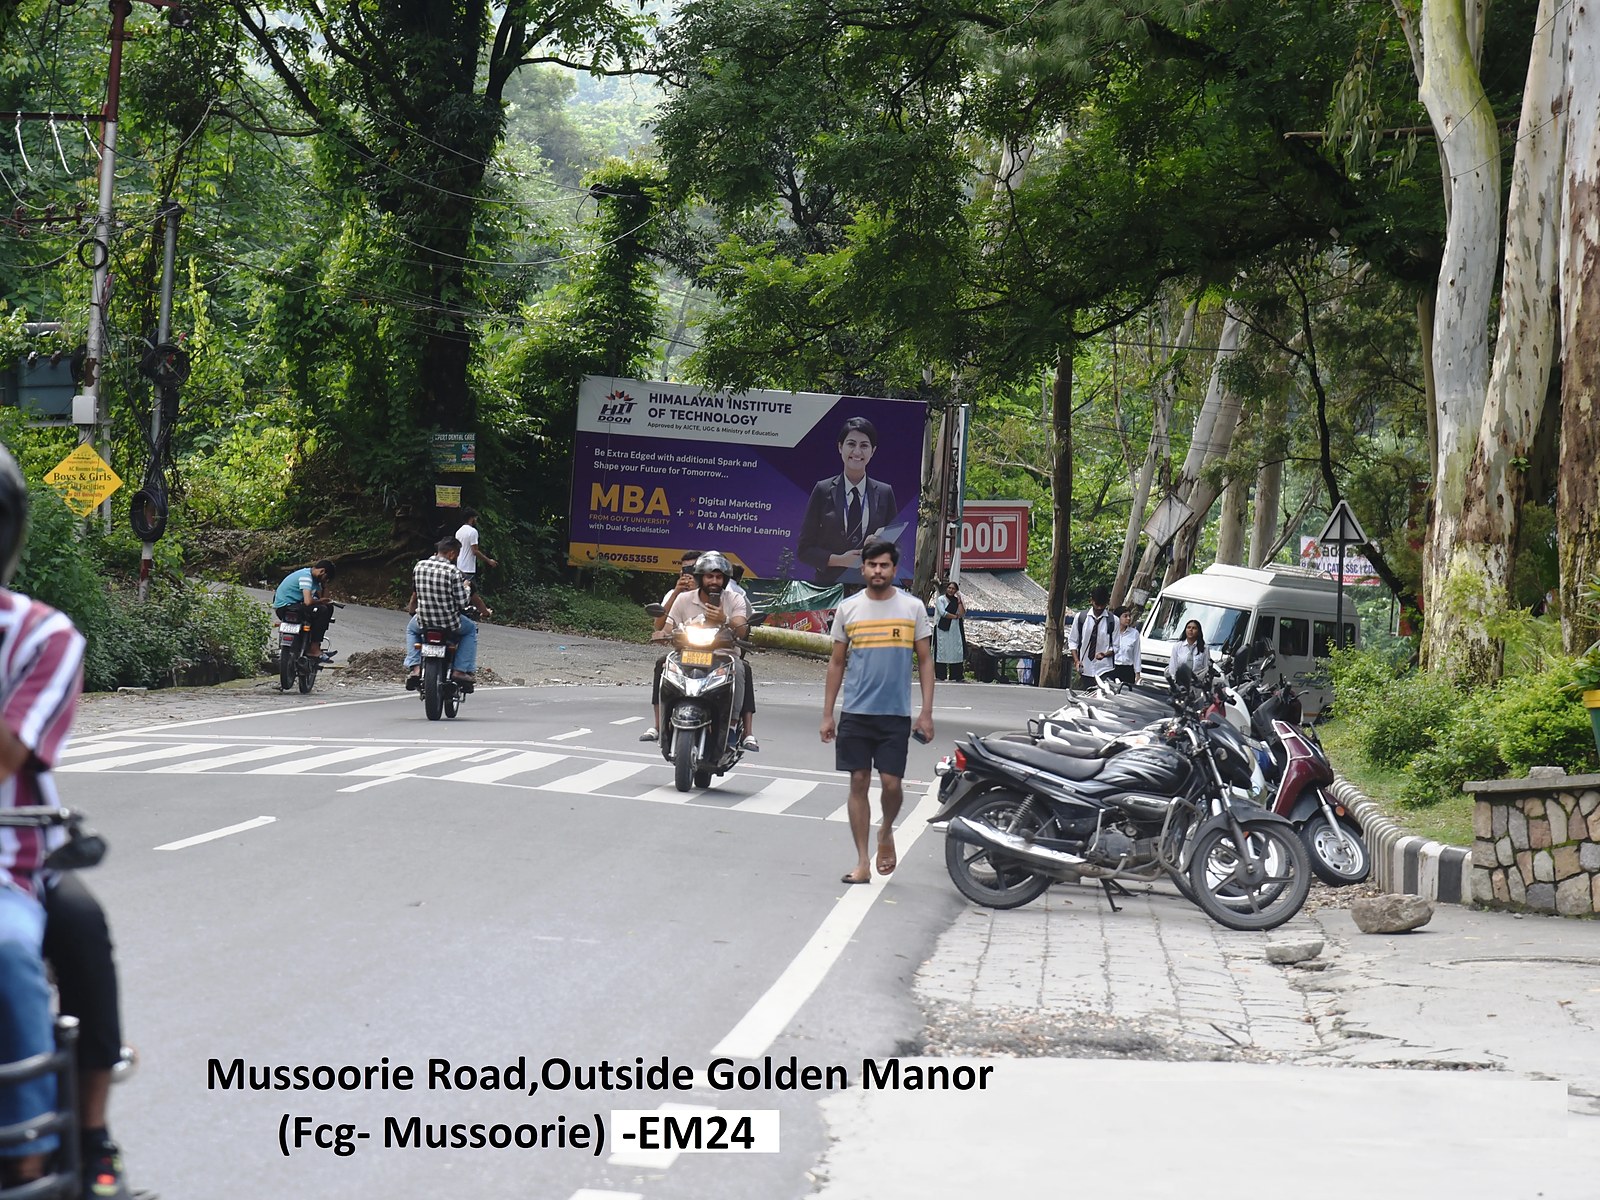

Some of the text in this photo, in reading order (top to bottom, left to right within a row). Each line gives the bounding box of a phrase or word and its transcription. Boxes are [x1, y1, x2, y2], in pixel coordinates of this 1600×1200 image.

[600, 402, 638, 415] HIT
[649, 393, 792, 414] HIMALAYAN INSTITUTE
[597, 415, 632, 423] DOON
[648, 408, 758, 425] OF TECHNOLOGY
[647, 422, 674, 430] Approved
[722, 427, 743, 435] Ministry
[594, 448, 758, 468] Be Extra Edged with additional Spark and
[593, 461, 729, 478] Shape your Future for Tomorrow...
[53, 472, 112, 482] Boys & Girls
[590, 482, 671, 516] MBA
[698, 496, 772, 511] Digital Marketing
[610, 515, 630, 523] GOVT
[631, 517, 671, 525] UNIVERSITY
[697, 509, 758, 521] Data Analytics
[606, 523, 622, 531] Dual
[623, 525, 670, 534] Specialisation
[696, 522, 791, 537] AI & Machine Learning
[892, 628, 901, 637] R
